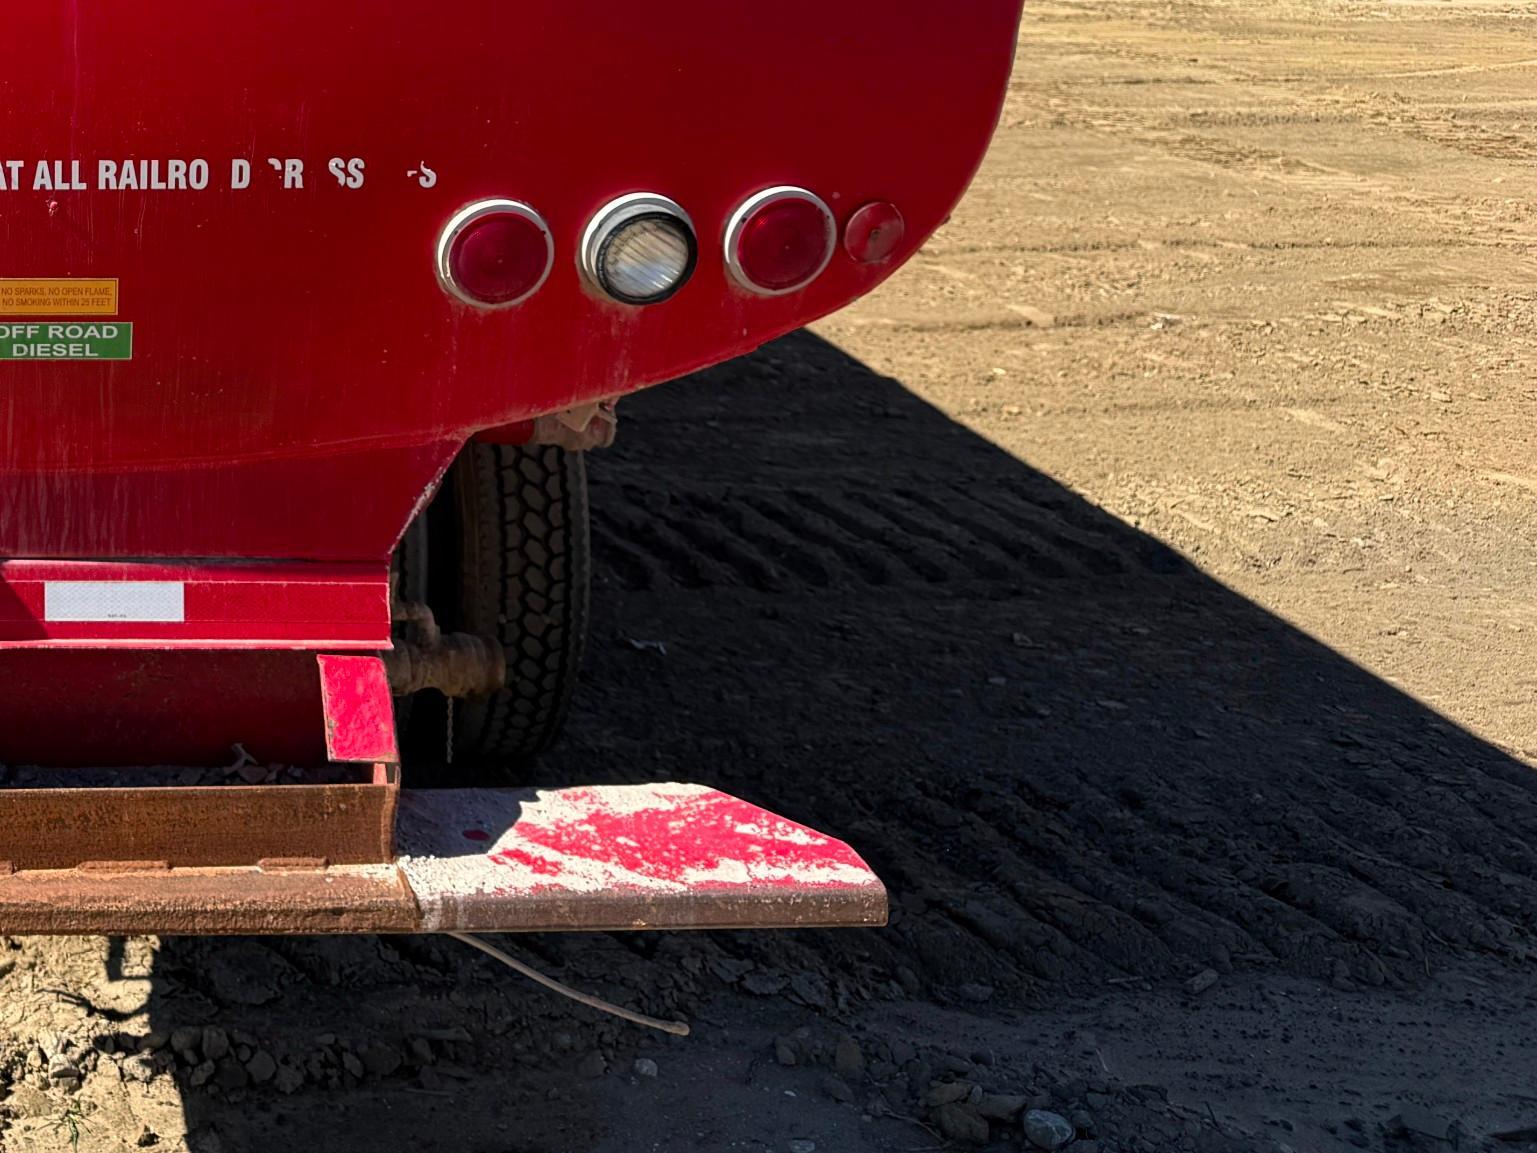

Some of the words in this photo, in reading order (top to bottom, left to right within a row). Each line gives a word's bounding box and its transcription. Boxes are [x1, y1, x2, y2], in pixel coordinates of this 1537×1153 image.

[32, 159, 88, 191] ALL
[97, 158, 251, 190] RAILROD
[1, 287, 13, 296] NO
[48, 287, 60, 296] NO
[61, 287, 84, 296] OPEN
[2, 298, 14, 306] NO
[15, 298, 51, 306] SMOKING
[52, 298, 80, 306] WITHIN
[91, 298, 112, 306] FEET
[48, 325, 119, 339] ROAD
[12, 343, 99, 357] DIESEL
